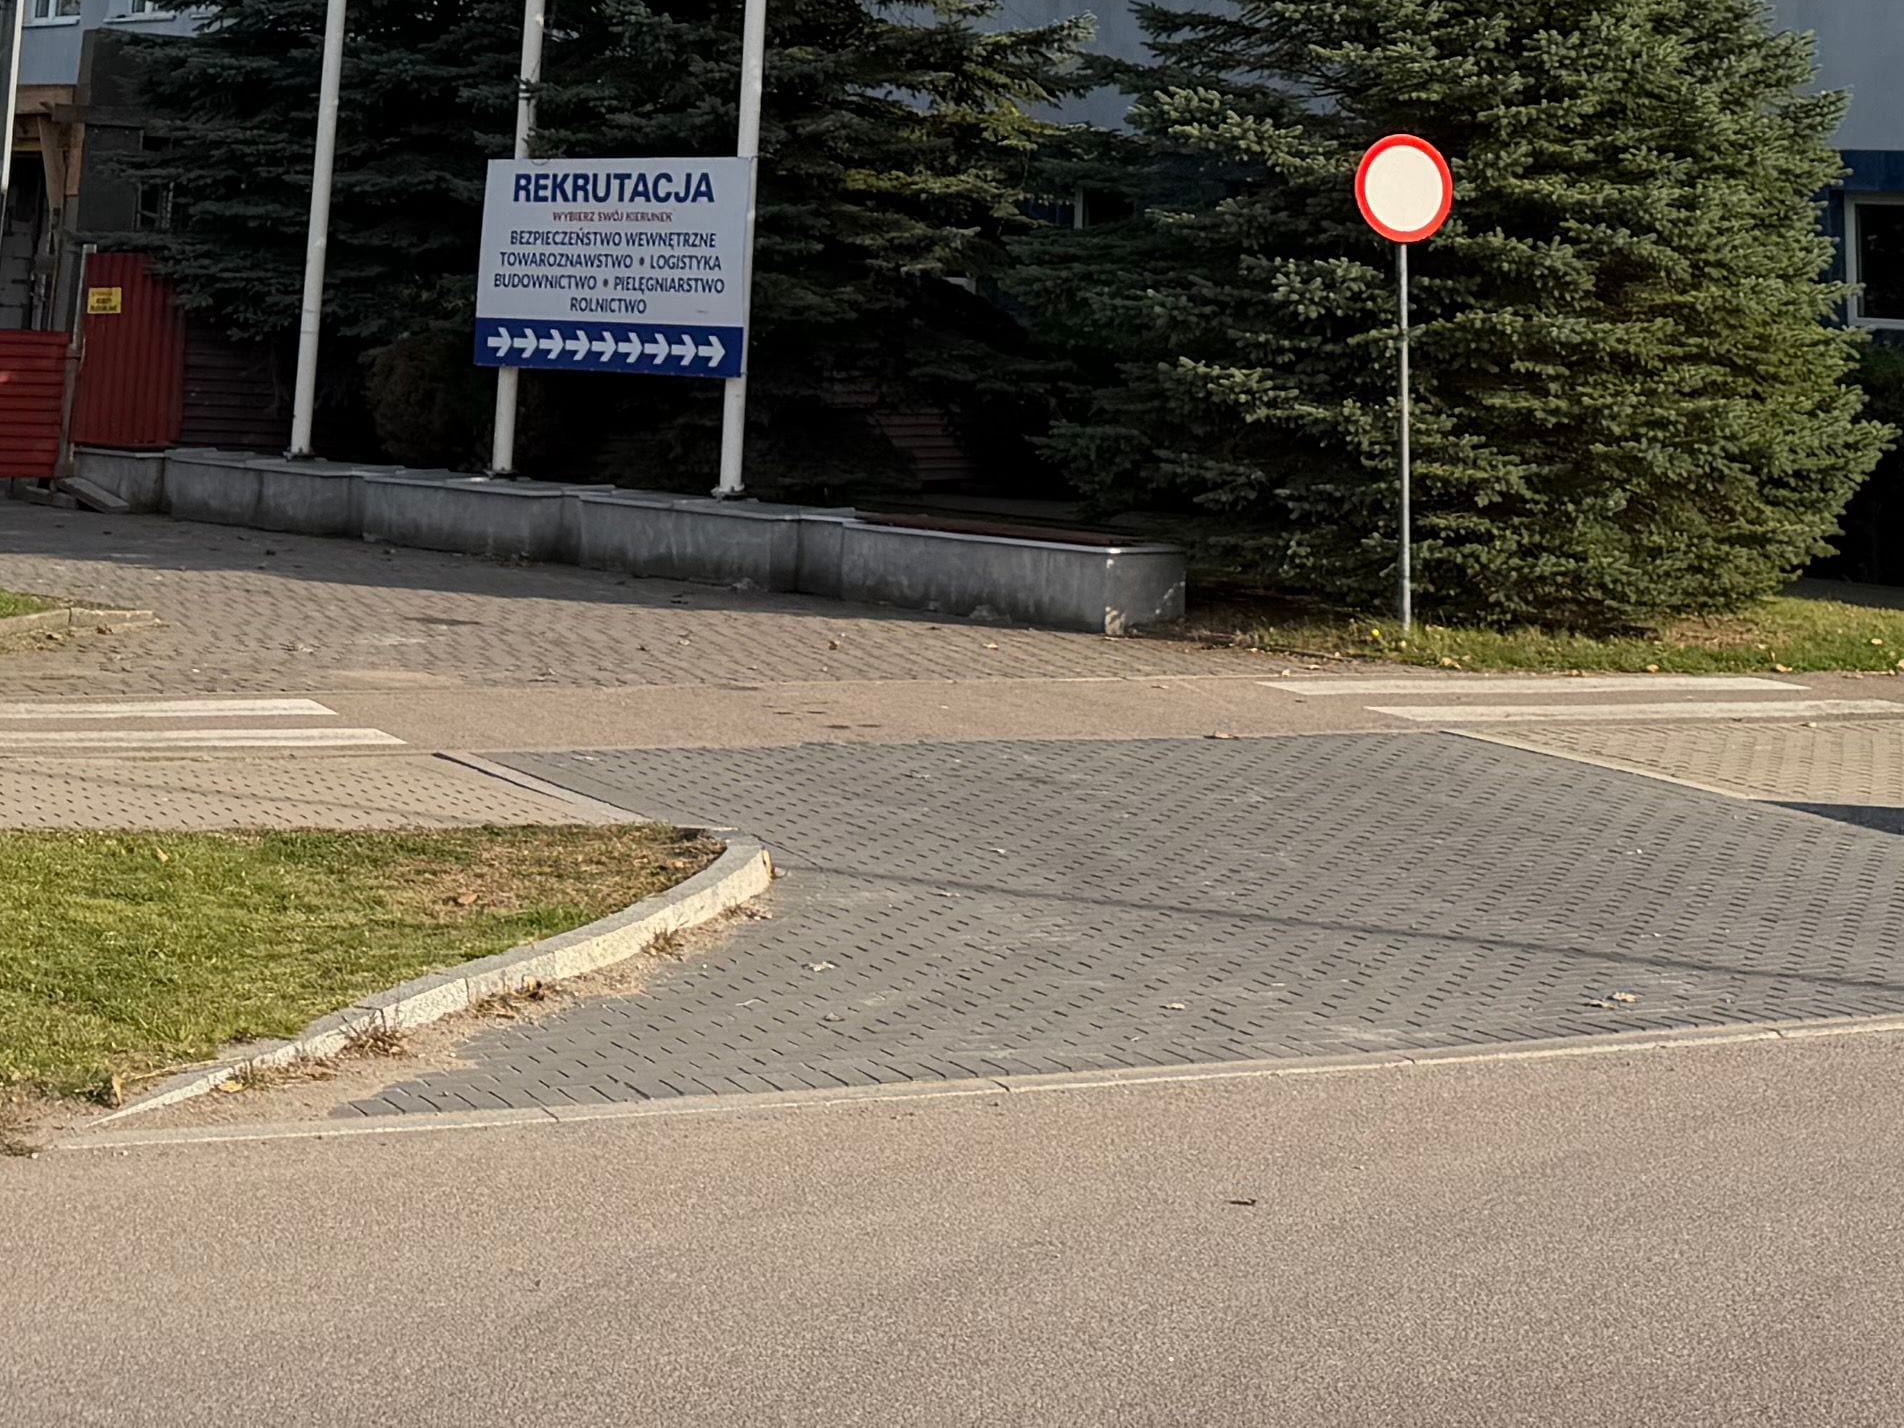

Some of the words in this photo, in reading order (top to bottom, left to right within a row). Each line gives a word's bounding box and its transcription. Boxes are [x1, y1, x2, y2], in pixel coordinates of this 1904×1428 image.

[513, 172, 715, 203] REKRUTACJA
[510, 227, 623, 247] BEZPIECZEŃSTWO
[625, 232, 717, 250] WEWNĘTRZNE
[499, 252, 634, 269] TOWAROZNAWSTWO
[650, 254, 722, 271] LOGISTYKA
[493, 273, 597, 290] BUDOWNICTWO
[613, 276, 725, 295] PIELĘGNIARSTWO
[570, 297, 647, 314] ROLNICTWO
